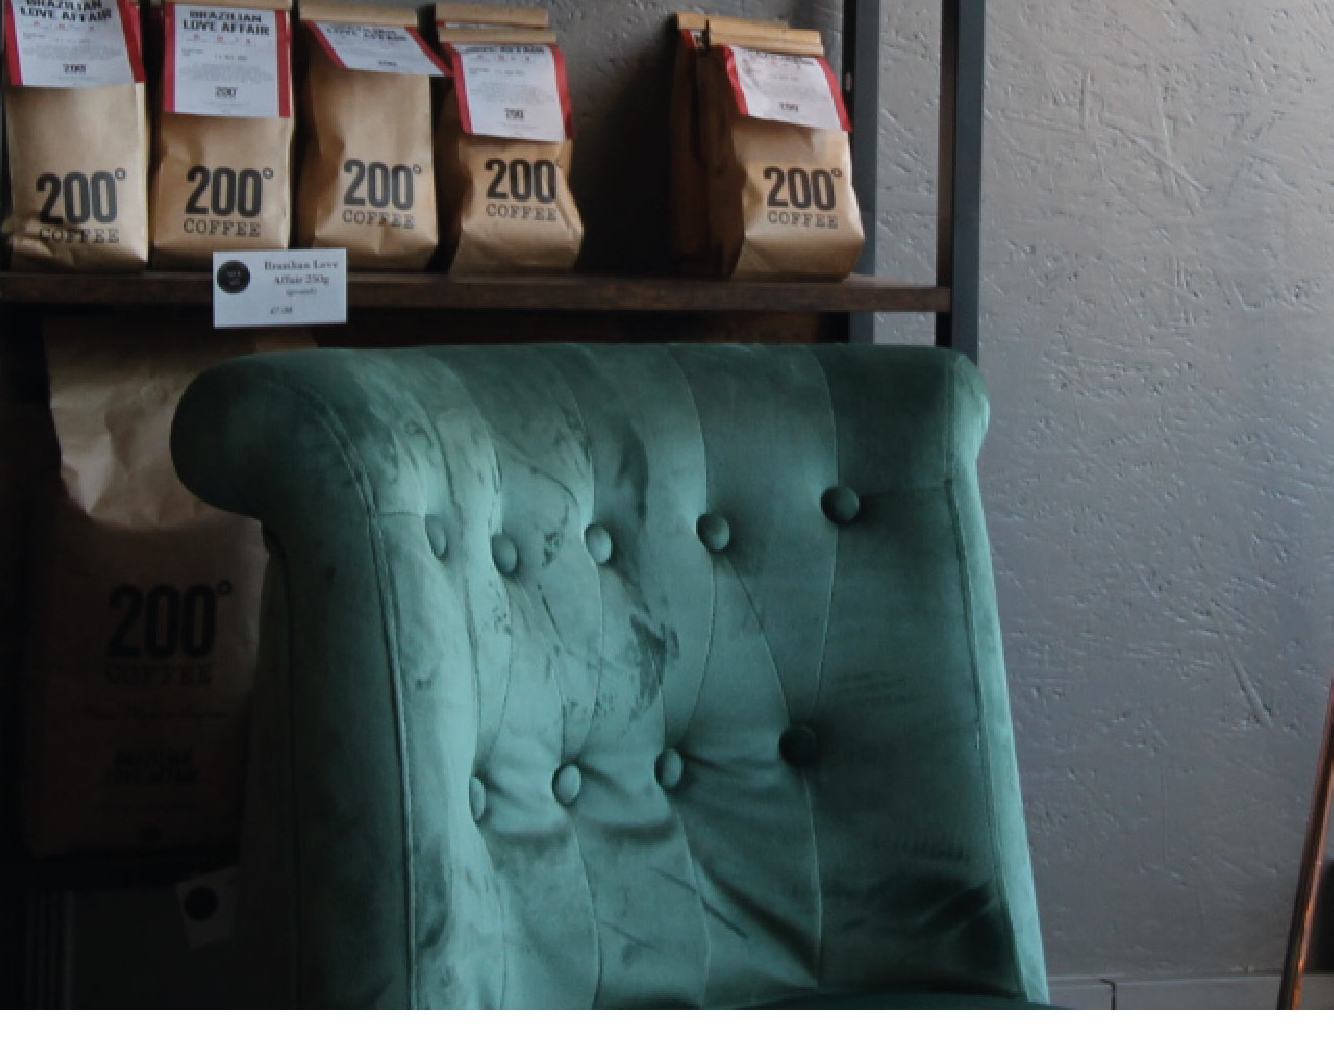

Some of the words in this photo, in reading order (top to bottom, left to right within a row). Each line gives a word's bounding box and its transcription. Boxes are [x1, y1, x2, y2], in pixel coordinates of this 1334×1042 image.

[20, 6, 55, 21] LOVE
[62, 7, 112, 23] AFFAIR
[189, 10, 262, 23] BRAZILIAN
[183, 19, 217, 33] LOVE
[221, 21, 270, 36] AFFAIR
[185, 164, 273, 218] 200°
[342, 209, 415, 230] COFFEE
[485, 203, 556, 222] COFFEE
[767, 210, 839, 230] COFFEE
[38, 228, 120, 245] COFFEE
[183, 218, 262, 237] COFFEE
[106, 662, 213, 686] COFFEE
